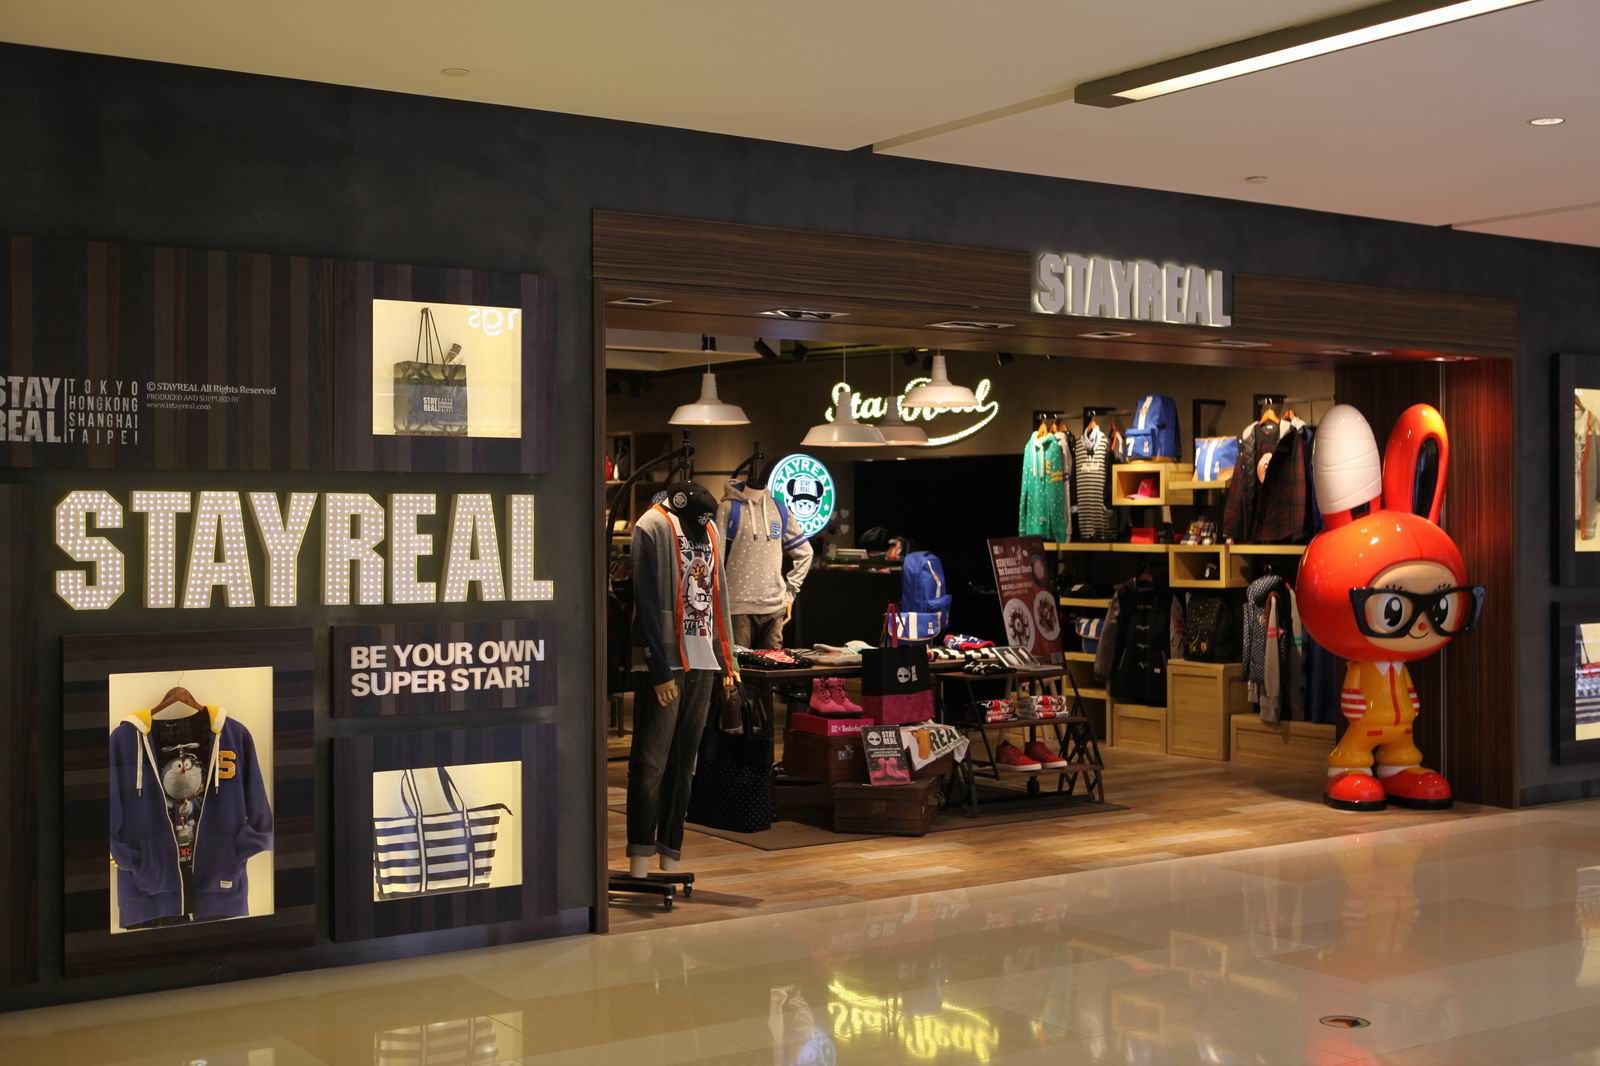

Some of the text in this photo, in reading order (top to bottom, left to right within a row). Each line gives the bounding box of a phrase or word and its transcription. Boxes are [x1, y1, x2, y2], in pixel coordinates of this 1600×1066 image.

[1034, 252, 1232, 327] STAYREAL
[68, 378, 139, 396] TOKYO
[200, 384, 212, 393] All
[213, 384, 239, 395] Rights
[239, 385, 277, 395] Reserved
[68, 395, 139, 412] HONGKONG
[146, 393, 183, 401] PRODUCED
[183, 394, 198, 402] AND
[198, 394, 230, 403] SUPPLIED
[422, 396, 438, 404] STAY
[423, 404, 438, 412] REAL
[68, 412, 139, 429] SHANGHAI
[68, 428, 139, 445] TAIPEI
[774, 458, 831, 497] STAYREAL
[54, 489, 555, 611] STAYREAL
[350, 639, 546, 670] BE YOUR OWN
[350, 665, 531, 699] SUPER STAR!
[881, 730, 896, 738] STAY
[882, 737, 898, 745] REAL
[218, 750, 238, 780] S
